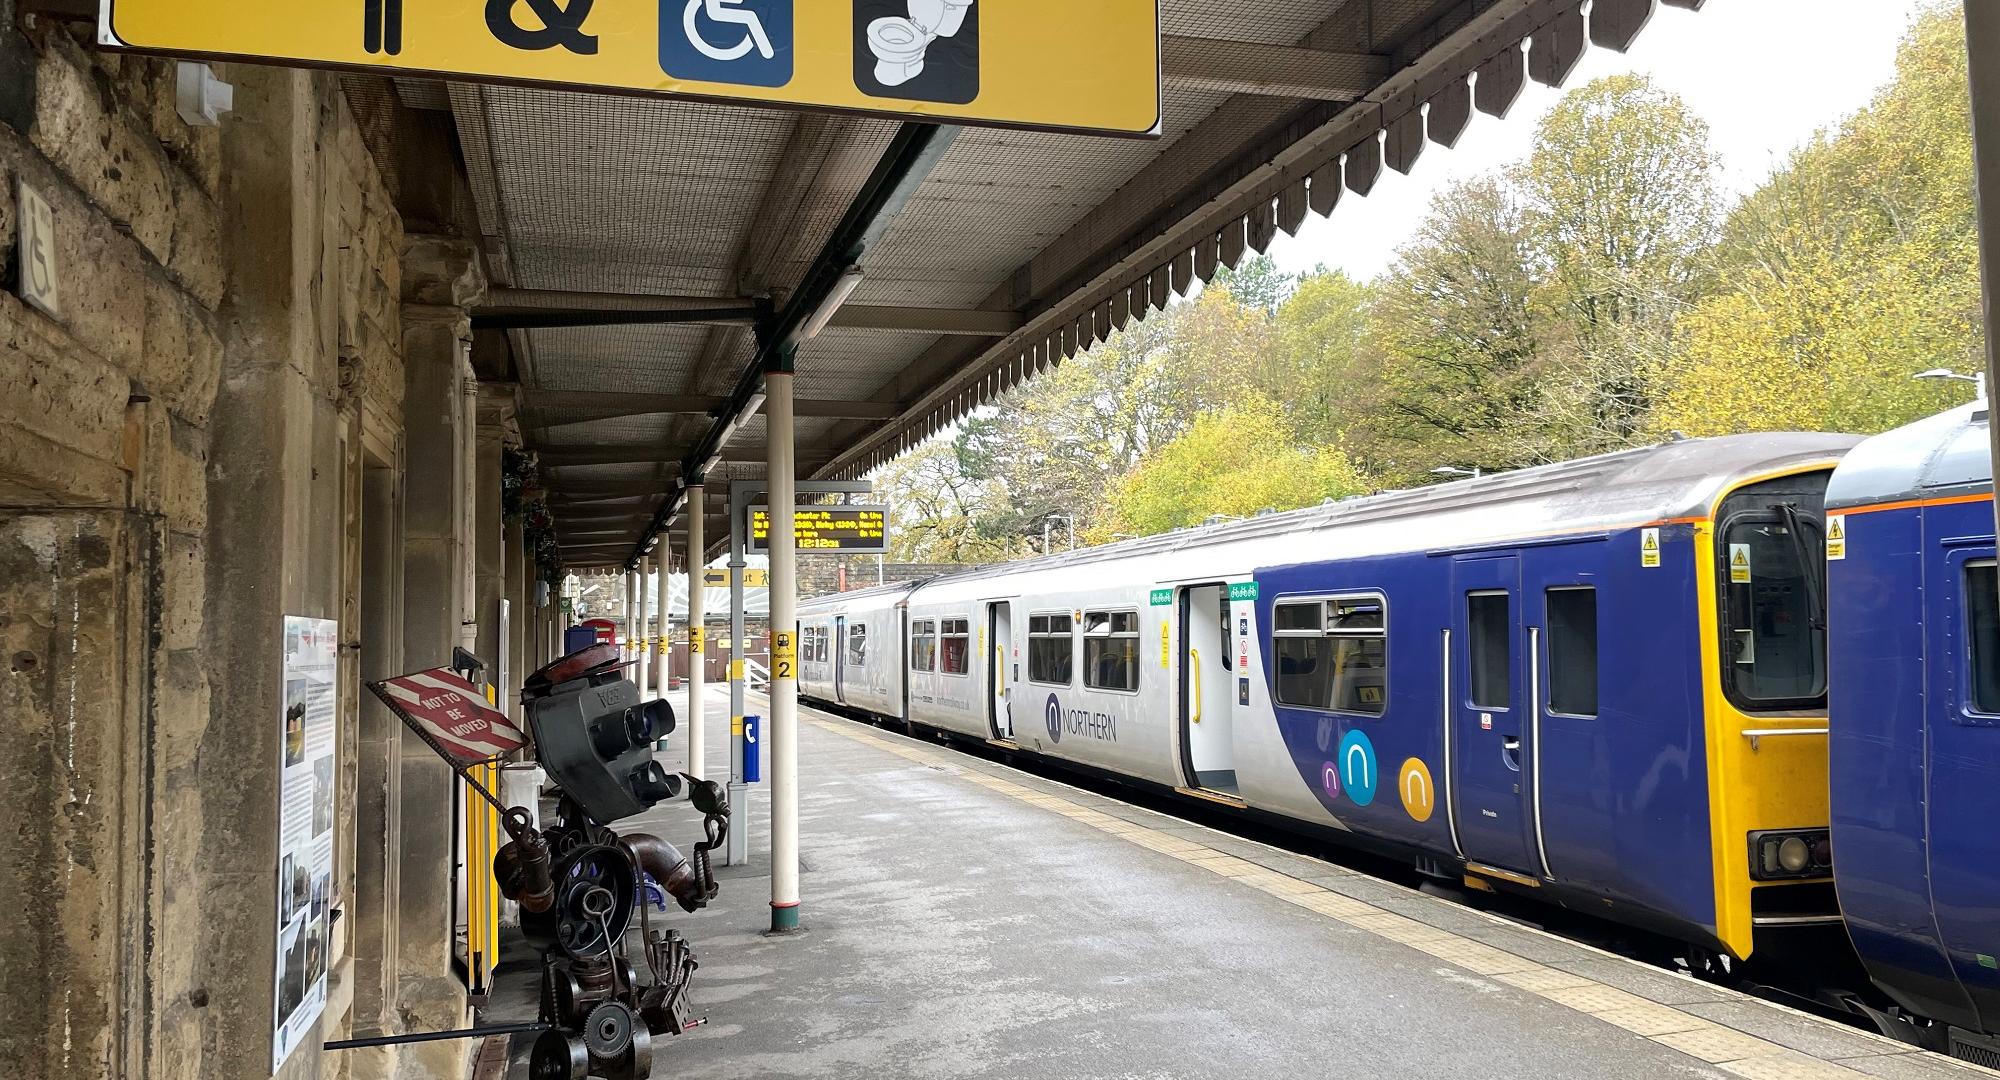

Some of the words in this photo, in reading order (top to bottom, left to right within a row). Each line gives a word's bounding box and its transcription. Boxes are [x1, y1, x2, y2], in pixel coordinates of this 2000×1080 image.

[692, 644, 699, 653] 2
[779, 662, 790, 678] 2
[421, 697, 443, 710] NOT
[444, 692, 461, 704] TO
[446, 708, 466, 721] BE
[450, 718, 488, 737] MOVED
[1062, 708, 1117, 743] NORTHERN
